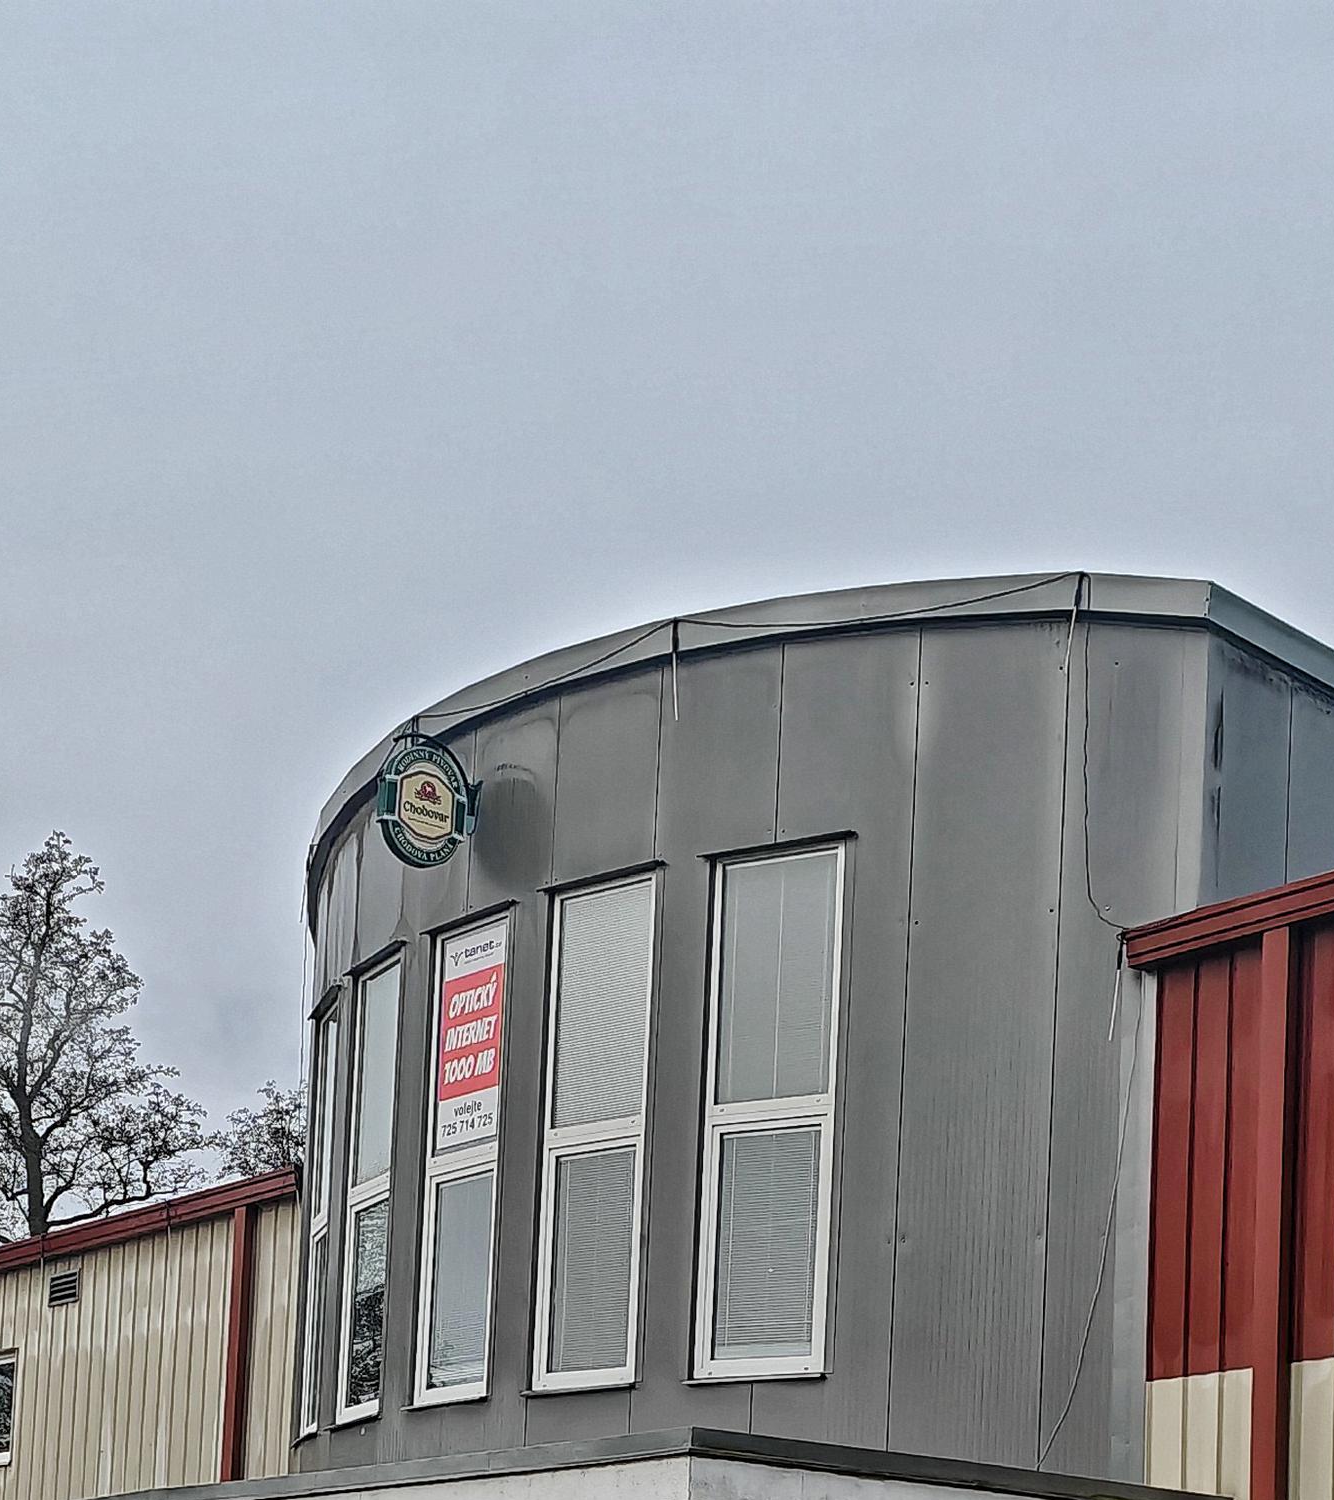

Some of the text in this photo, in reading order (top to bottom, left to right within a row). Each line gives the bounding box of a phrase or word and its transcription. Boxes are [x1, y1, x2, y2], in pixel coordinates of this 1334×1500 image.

[403, 800, 450, 823] Chodovar
[448, 971, 498, 1020] OPTICKÝ
[444, 1014, 499, 1053] INTERNET
[443, 1047, 496, 1086] 1000 MB
[453, 1099, 482, 1118] volejte
[441, 1112, 493, 1138] 725 714 725
